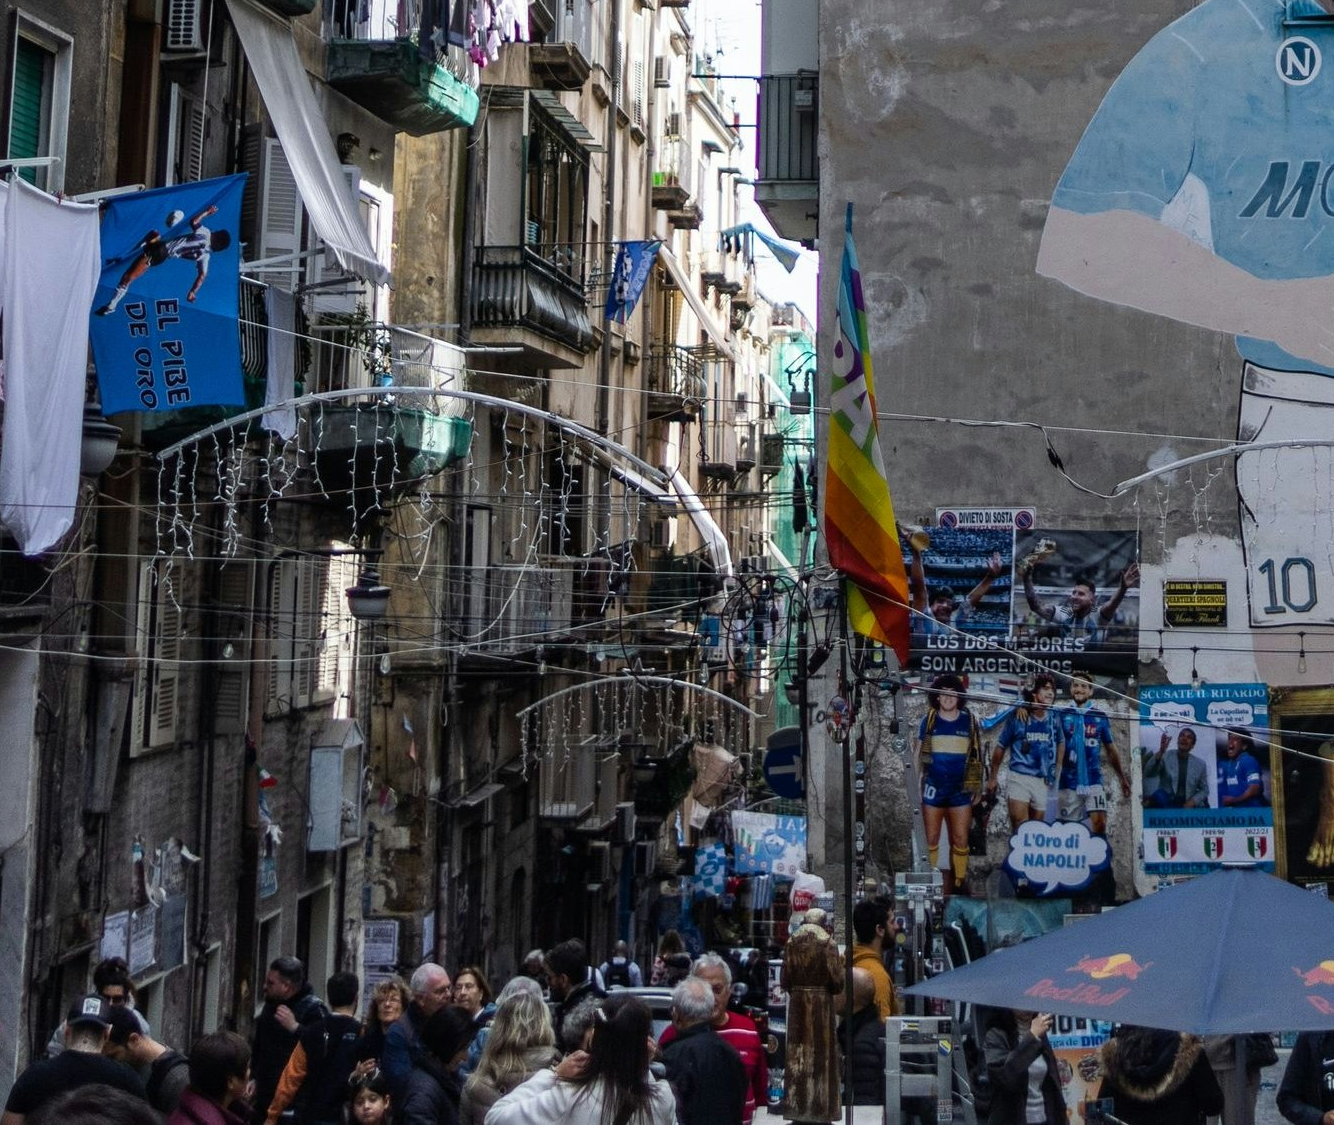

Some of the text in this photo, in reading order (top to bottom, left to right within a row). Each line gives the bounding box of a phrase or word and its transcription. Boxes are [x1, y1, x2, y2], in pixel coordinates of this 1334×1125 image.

[124, 301, 158, 410] DE ORO
[155, 298, 190, 406] EL PIBE
[959, 511, 1014, 524] DIVIETO DI SOSTA
[1258, 557, 1318, 615] 10
[927, 634, 1085, 652] LOS DOS MEJORES
[921, 656, 956, 672] SON
[1140, 689, 1194, 700] SCUSATE
[1211, 688, 1266, 699] RITARDO
[923, 783, 937, 800] 10
[1094, 795, 1105, 808] 14
[1148, 815, 1265, 826] RICOMINCIAMO DA
[1023, 833, 1079, 849] L'Oro di
[1023, 853, 1087, 869] NAPOLI!
